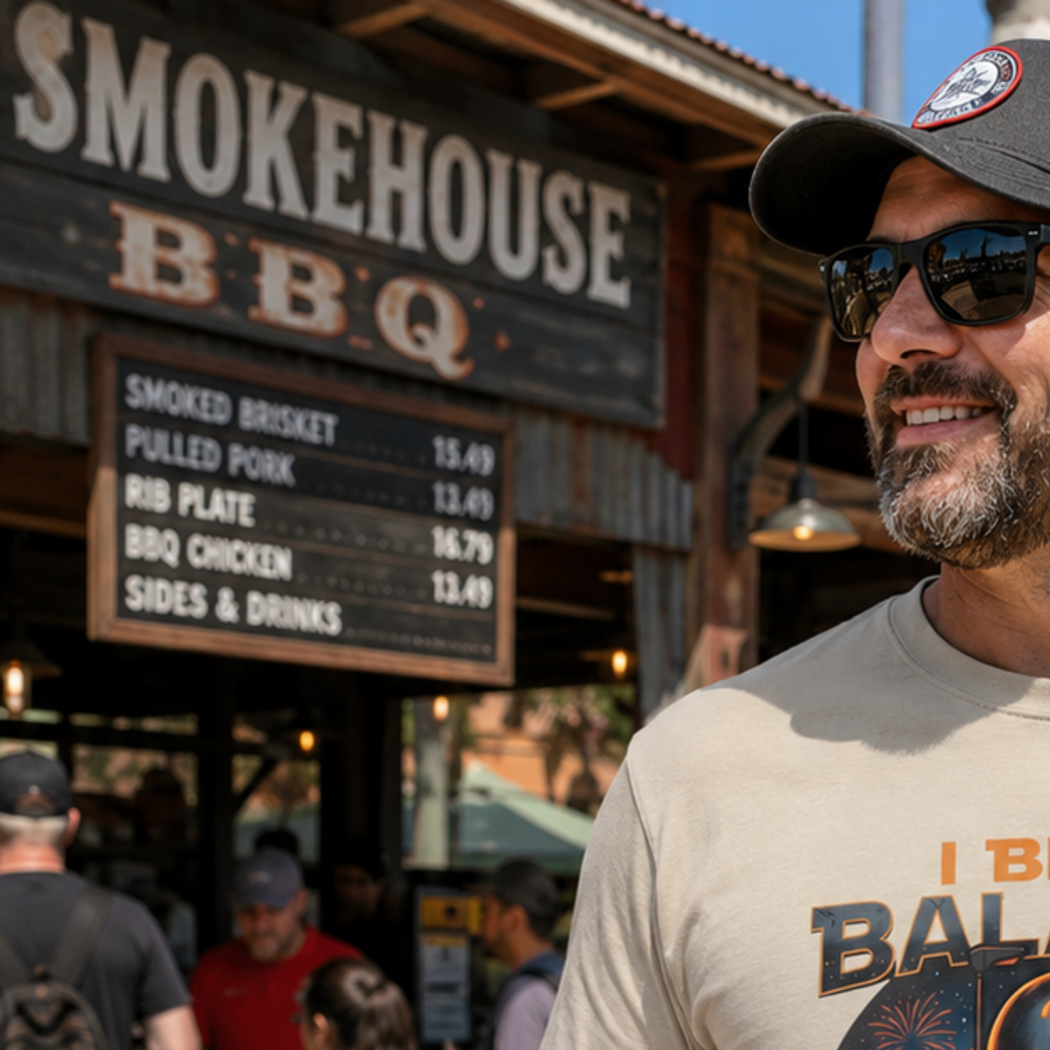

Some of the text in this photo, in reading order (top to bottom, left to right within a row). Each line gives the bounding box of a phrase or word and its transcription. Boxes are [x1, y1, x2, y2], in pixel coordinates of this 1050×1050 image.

[14, 3, 632, 309] SMOKEHOUSE
[109, 200, 474, 381] BBQ
[125, 373, 339, 446] SMOKED BRISKET
[125, 423, 296, 487] PULLED PORK
[125, 472, 256, 528] RIB PLATE
[125, 523, 293, 581] BBQ CHICKEN
[125, 574, 342, 637] SIDES & DRINKS
[940, 841, 958, 886] I
